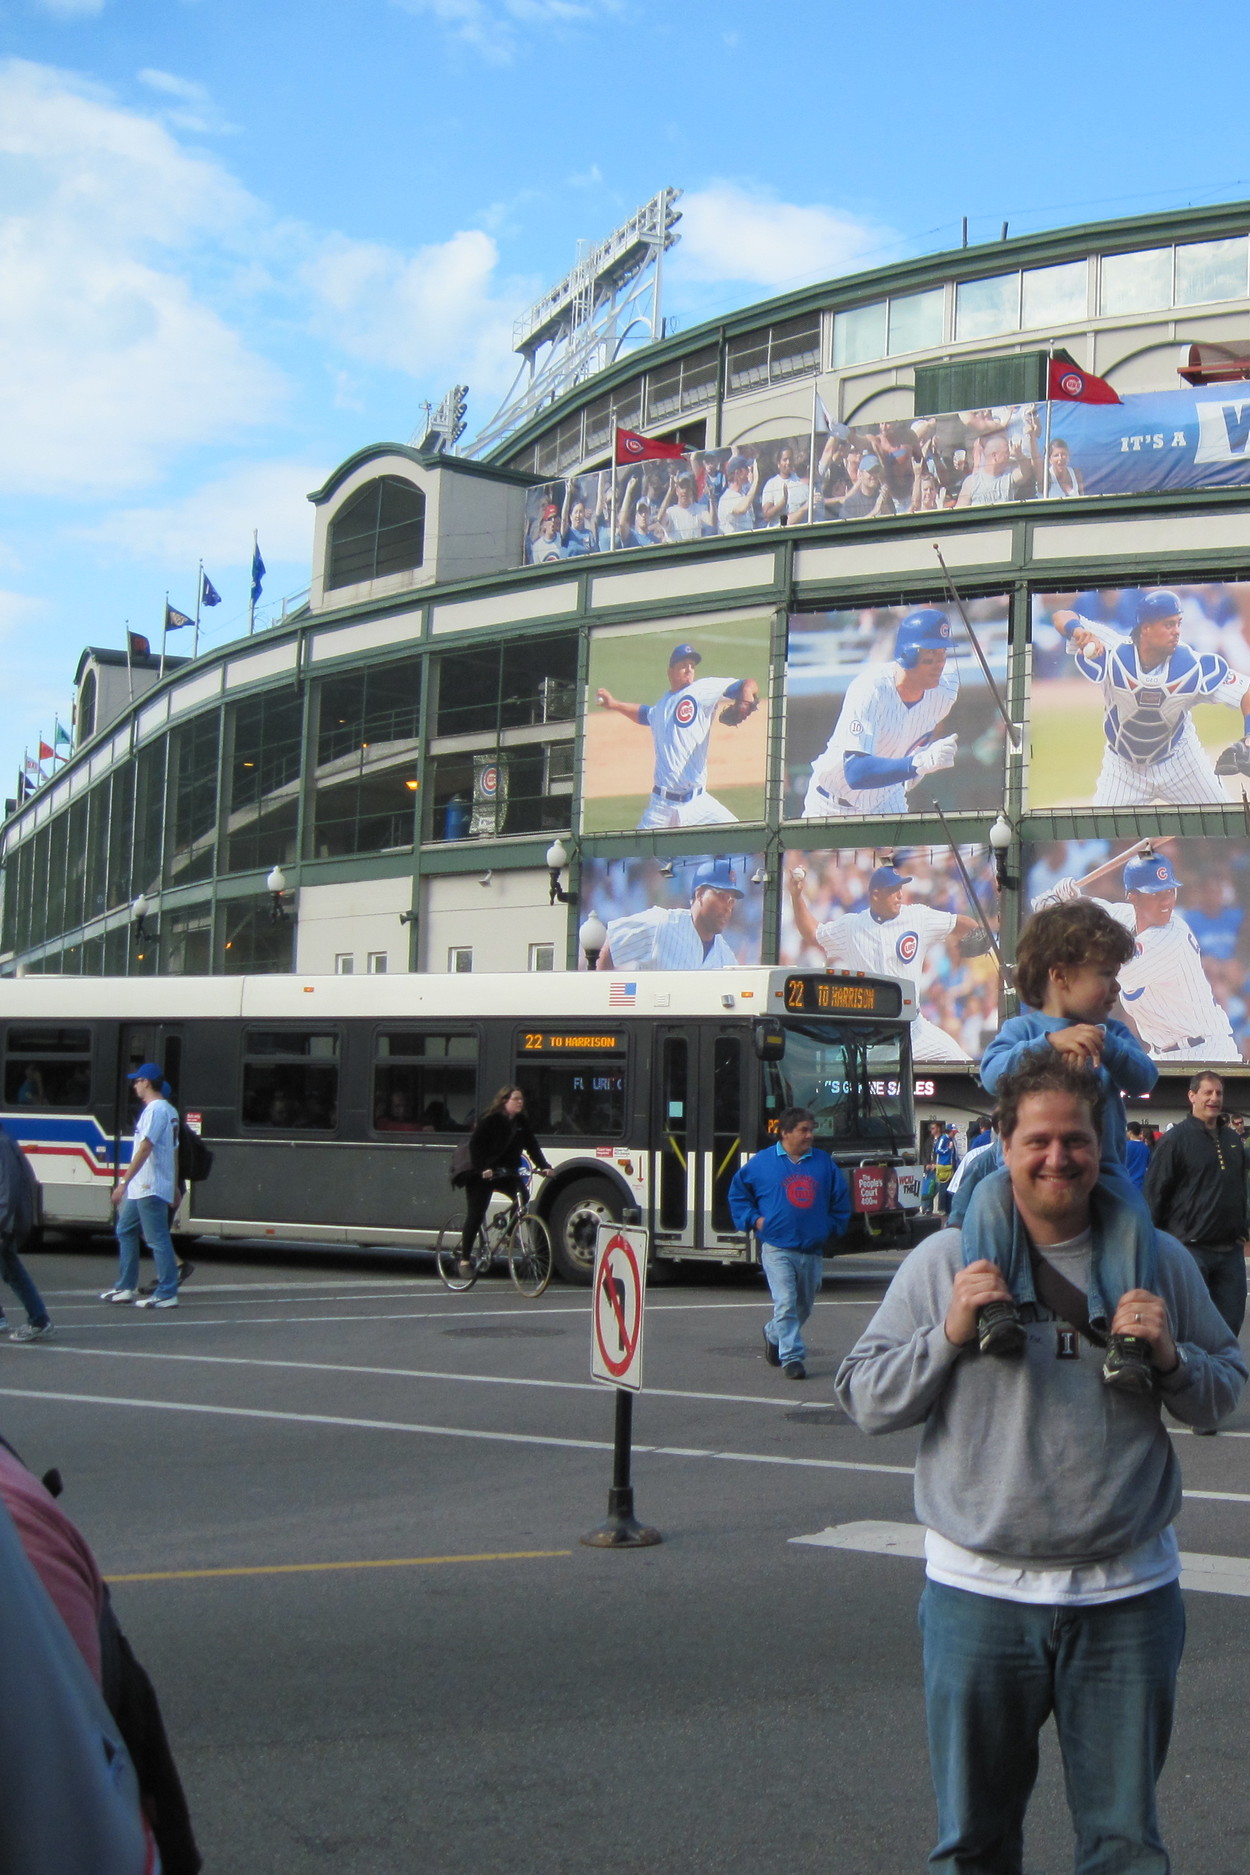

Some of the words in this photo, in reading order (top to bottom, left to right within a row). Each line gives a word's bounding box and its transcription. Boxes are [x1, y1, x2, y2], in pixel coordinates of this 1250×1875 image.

[1121, 436, 1164, 452] IT'S
[1171, 431, 1187, 447] A
[1157, 867, 1168, 880] C
[789, 980, 804, 1007] 22
[818, 985, 829, 1007] TO
[831, 986, 876, 1009] HARRISON
[525, 1034, 543, 1049] 22
[550, 1037, 563, 1047] TO
[565, 1037, 616, 1047] HARRISON
[859, 1179, 883, 1188] People's
[903, 1184, 915, 1194] THE
[860, 1188, 878, 1197] Court
